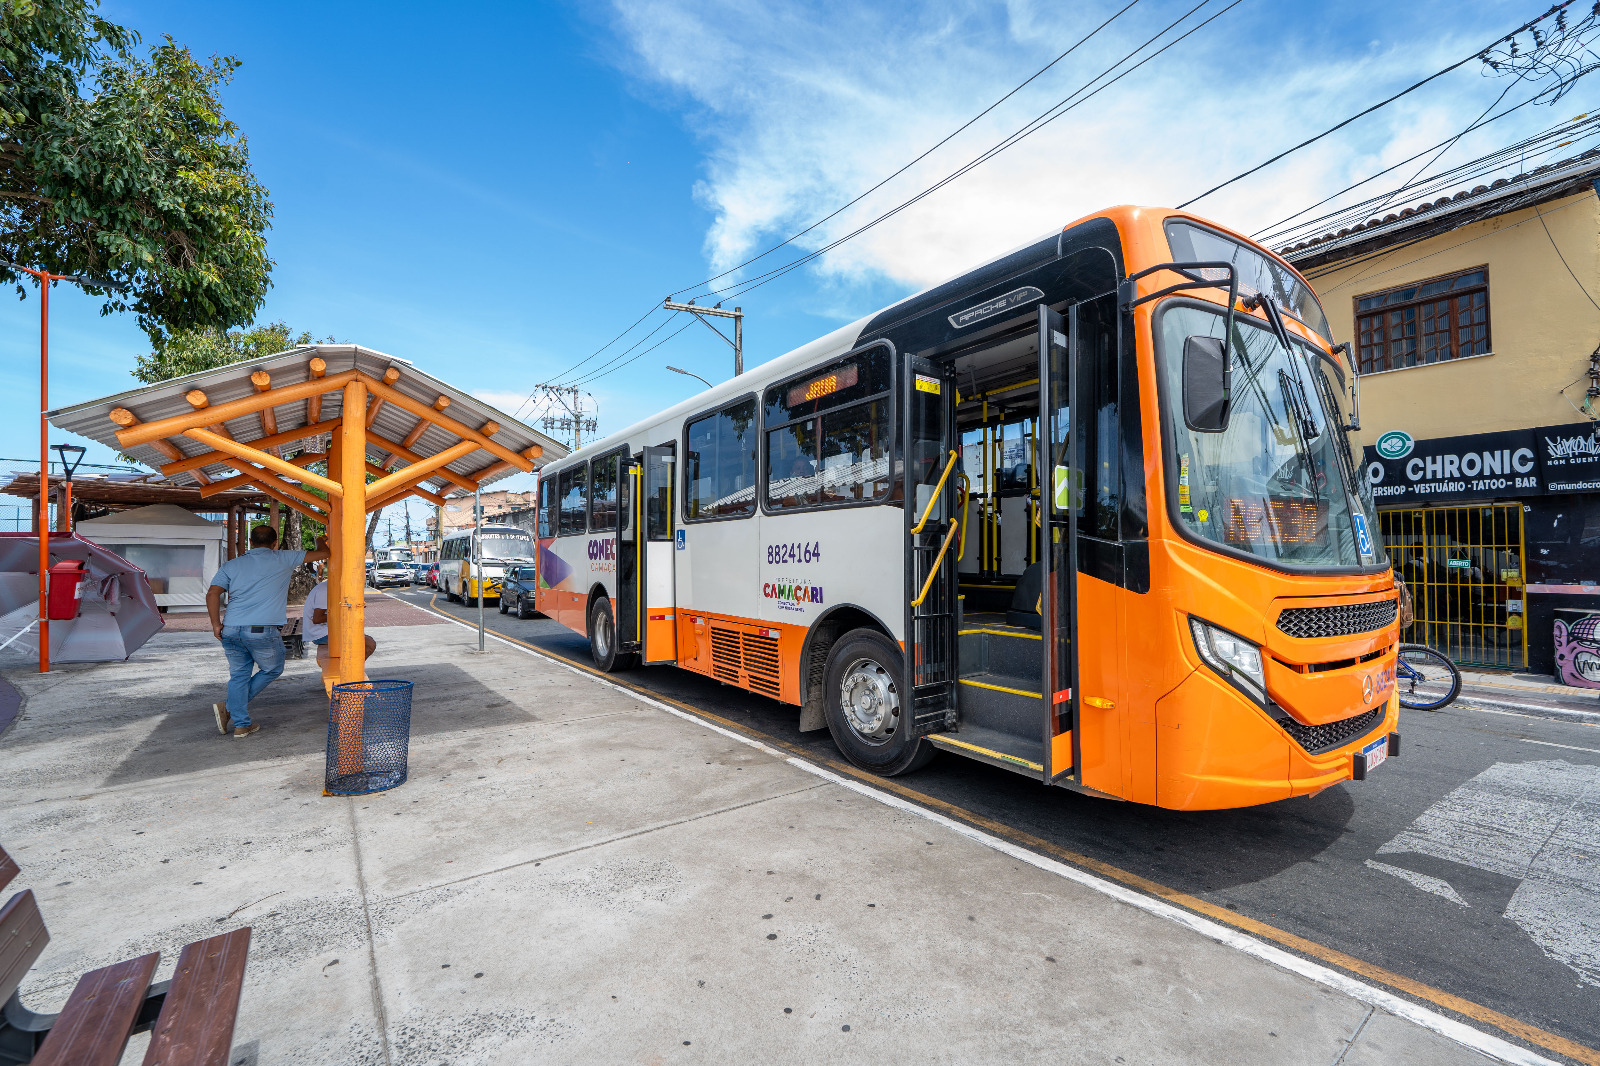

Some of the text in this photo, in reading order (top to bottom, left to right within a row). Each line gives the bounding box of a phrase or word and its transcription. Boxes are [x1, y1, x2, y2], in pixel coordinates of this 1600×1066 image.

[959, 290, 1028, 323] APACHE VIP
[1367, 447, 1535, 484] O CHRONIC
[1515, 476, 1537, 488] BAR
[767, 541, 821, 564] 8824164
[763, 582, 824, 605] CAMAÇARI
